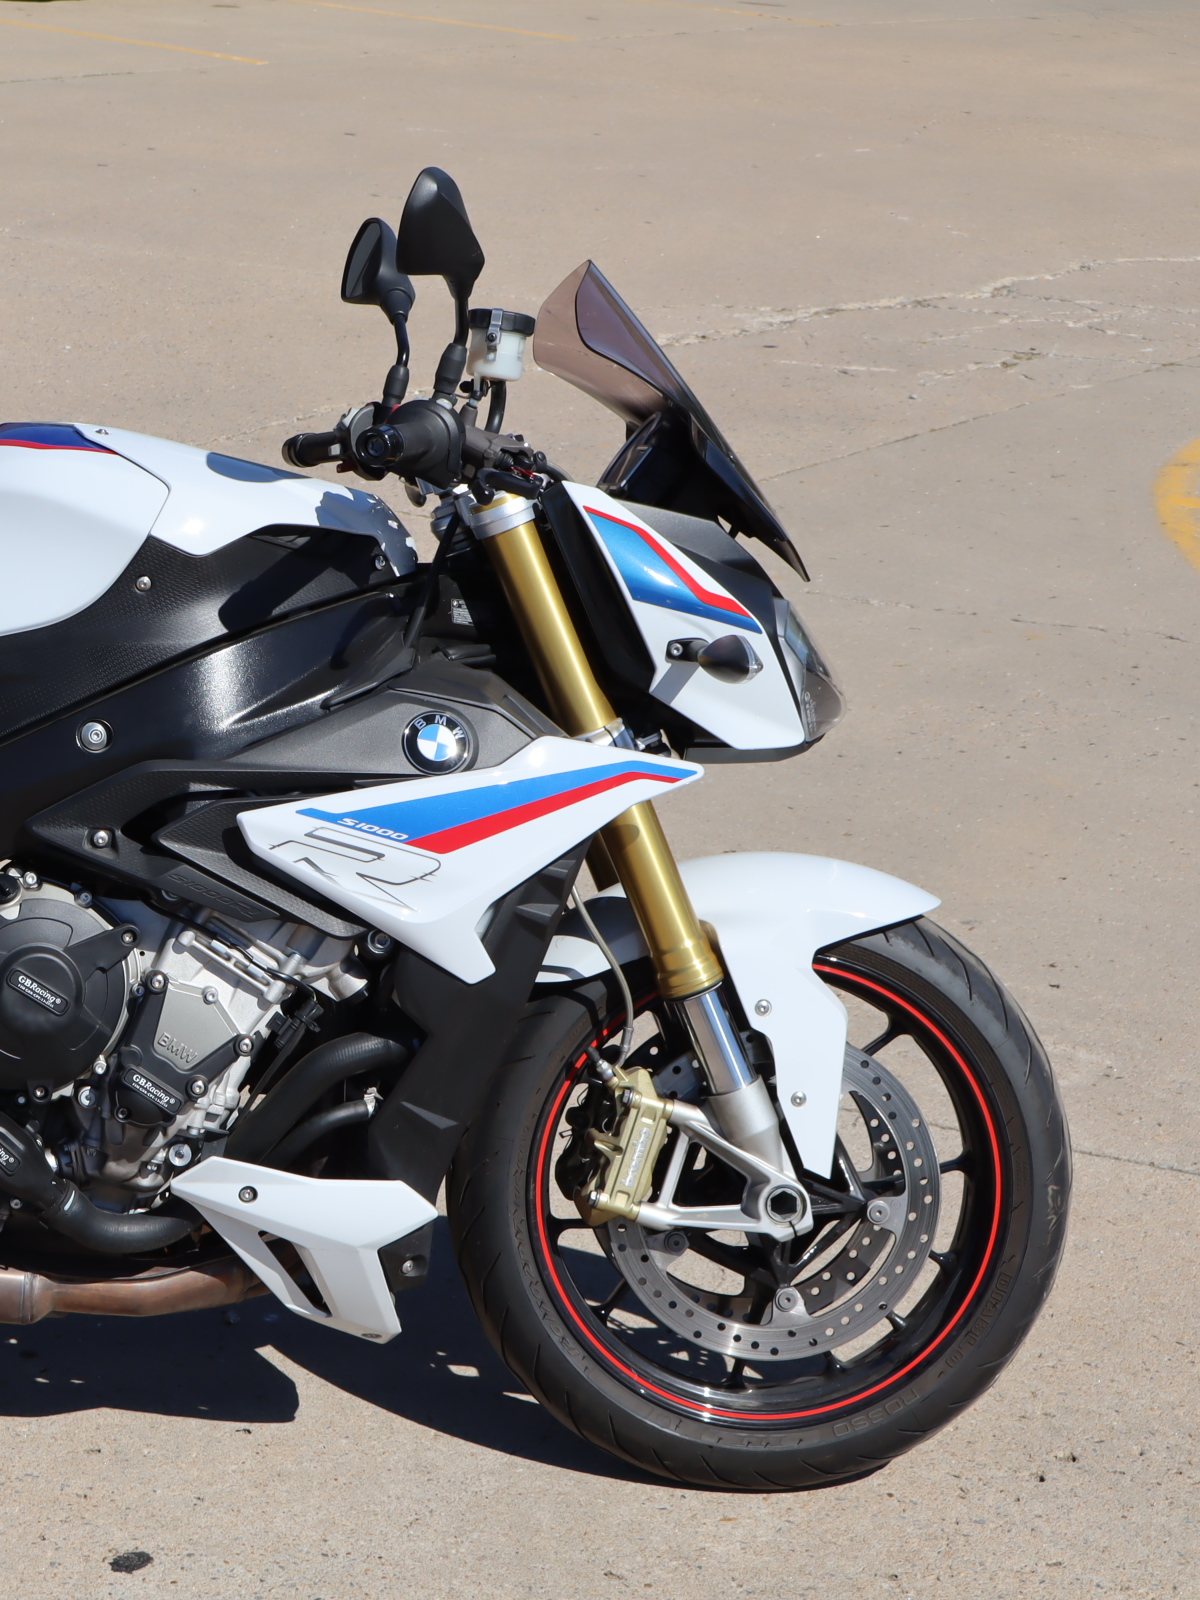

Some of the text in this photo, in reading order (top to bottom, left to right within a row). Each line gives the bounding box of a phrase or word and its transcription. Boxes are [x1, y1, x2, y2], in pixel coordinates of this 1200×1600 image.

[413, 714, 466, 740] BMW
[337, 817, 409, 841] S1000
[157, 1031, 198, 1064] BMW
[620, 1127, 651, 1188] brembo
[832, 1389, 920, 1437] ROSSO
